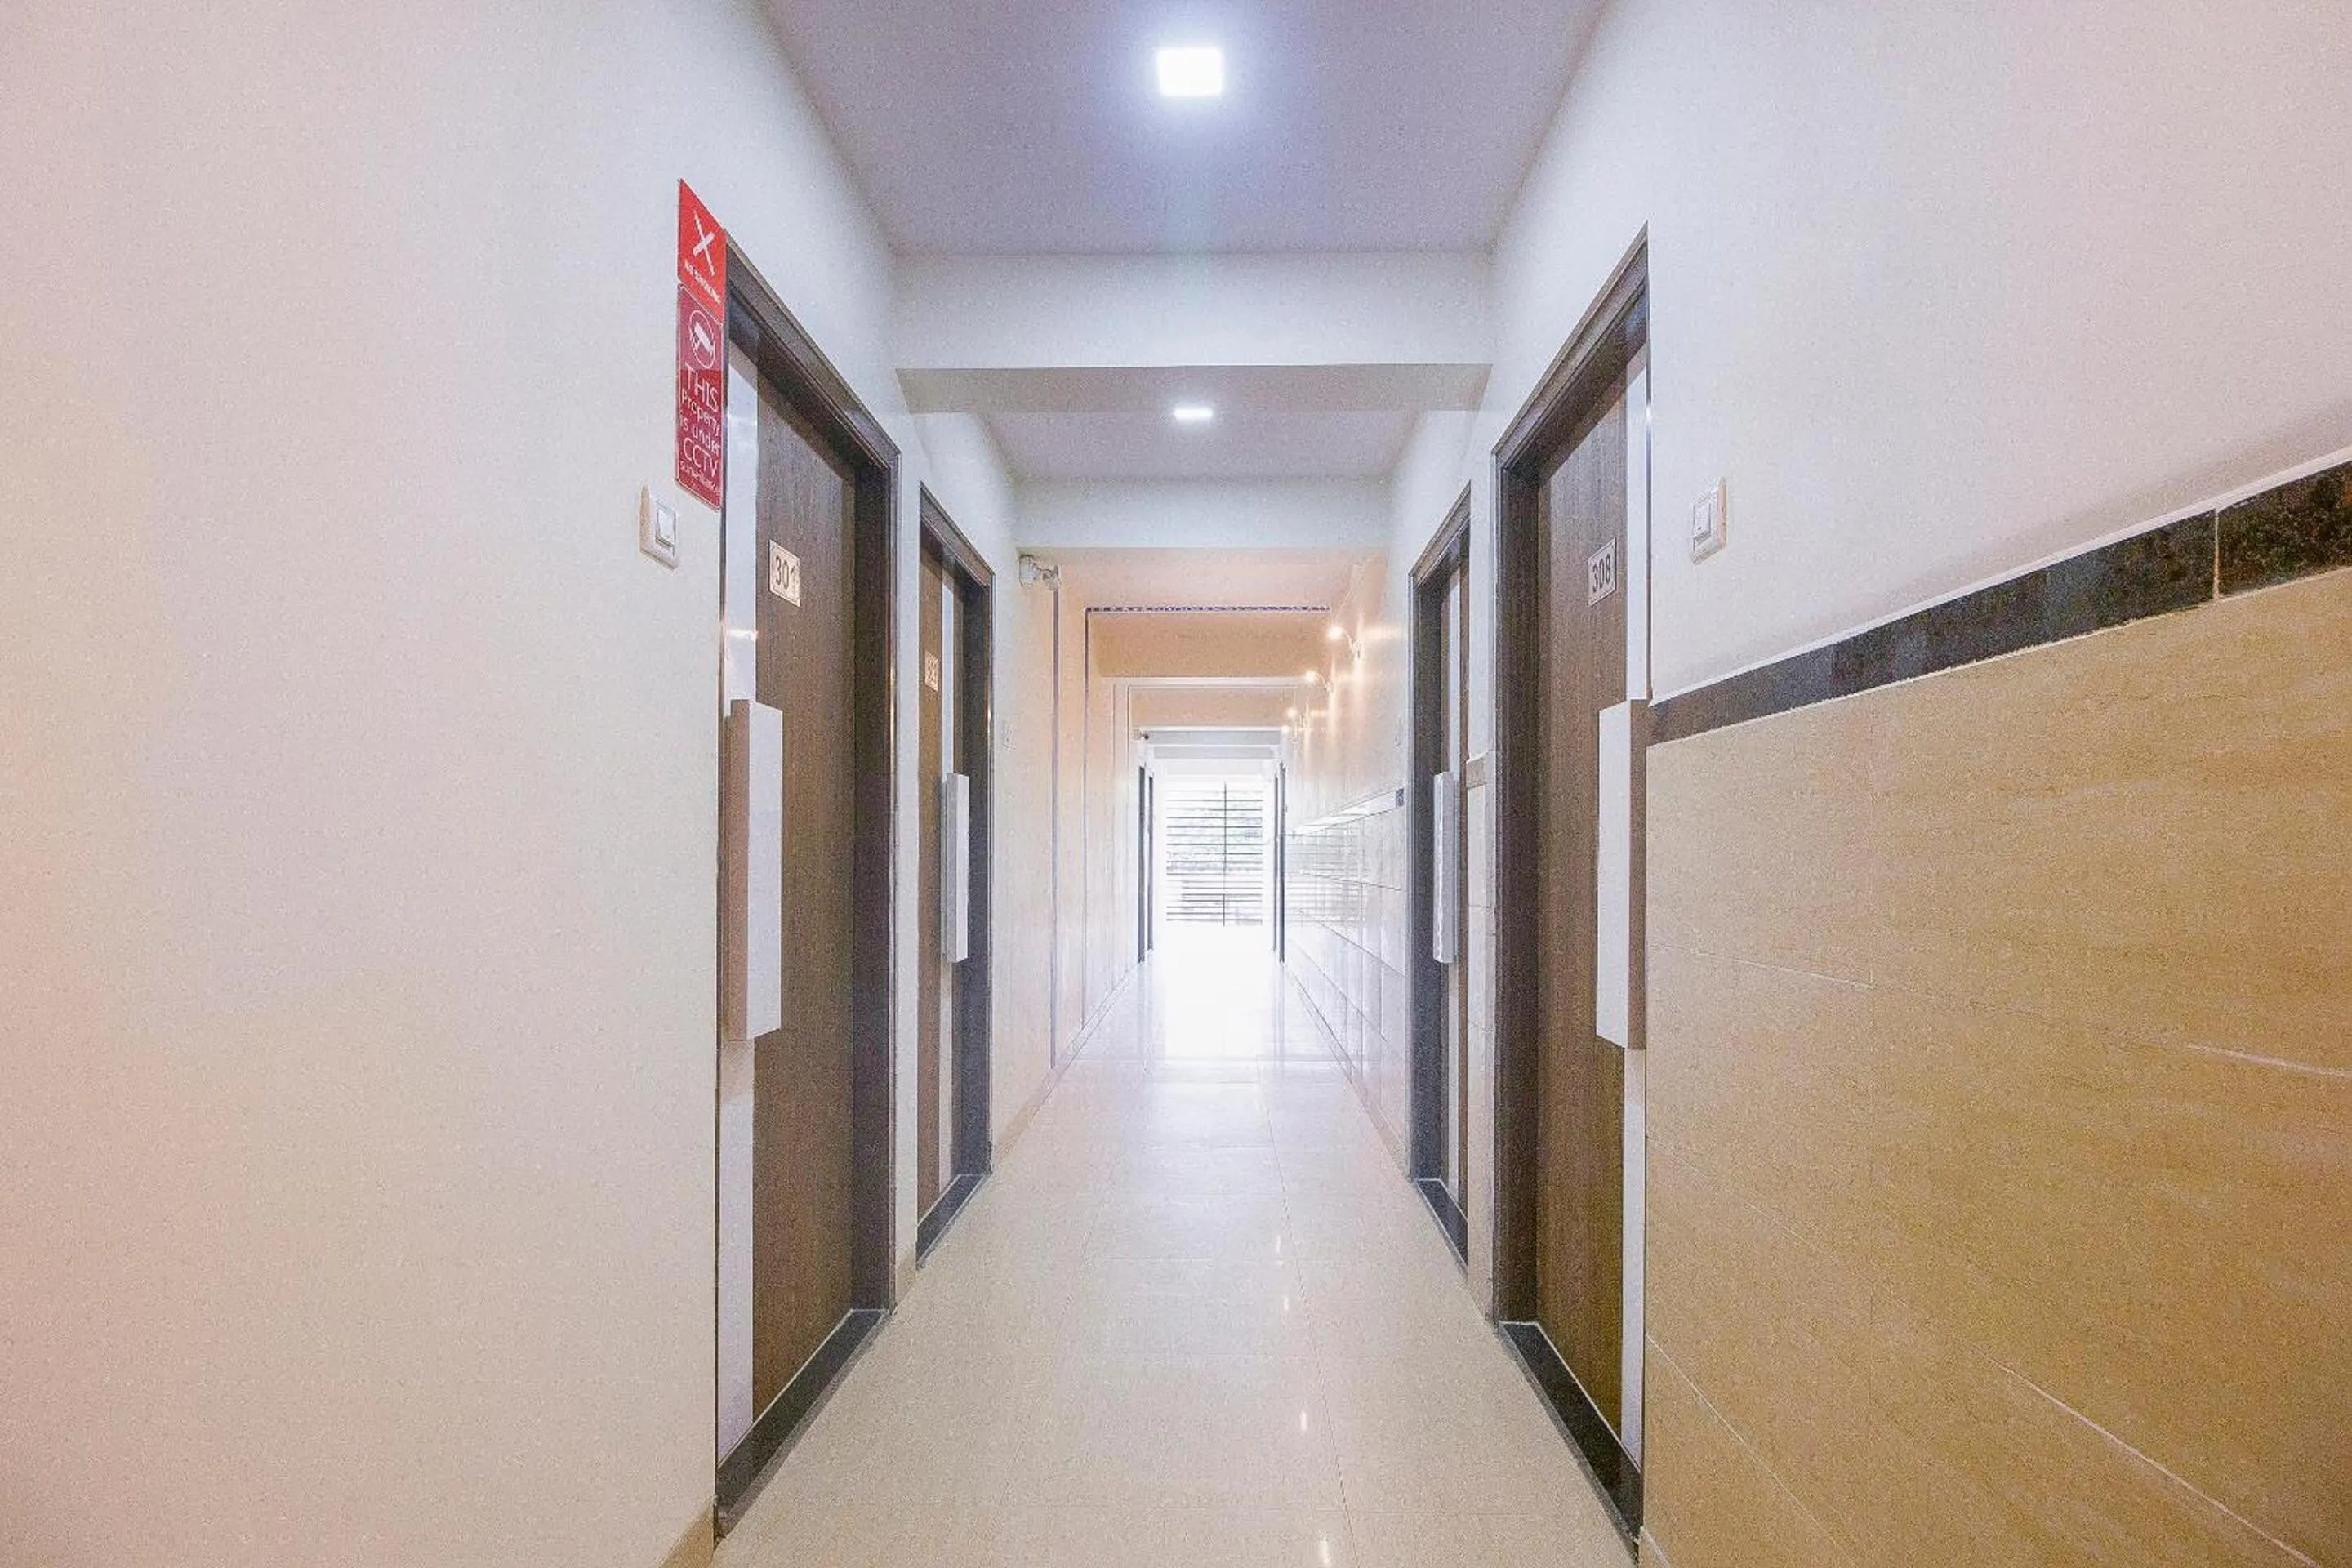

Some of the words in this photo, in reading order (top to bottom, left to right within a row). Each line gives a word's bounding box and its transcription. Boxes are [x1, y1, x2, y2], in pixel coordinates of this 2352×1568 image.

[685, 362, 719, 412] THIS
[684, 437, 719, 478] CCTV
[1592, 554, 1610, 593] 308
